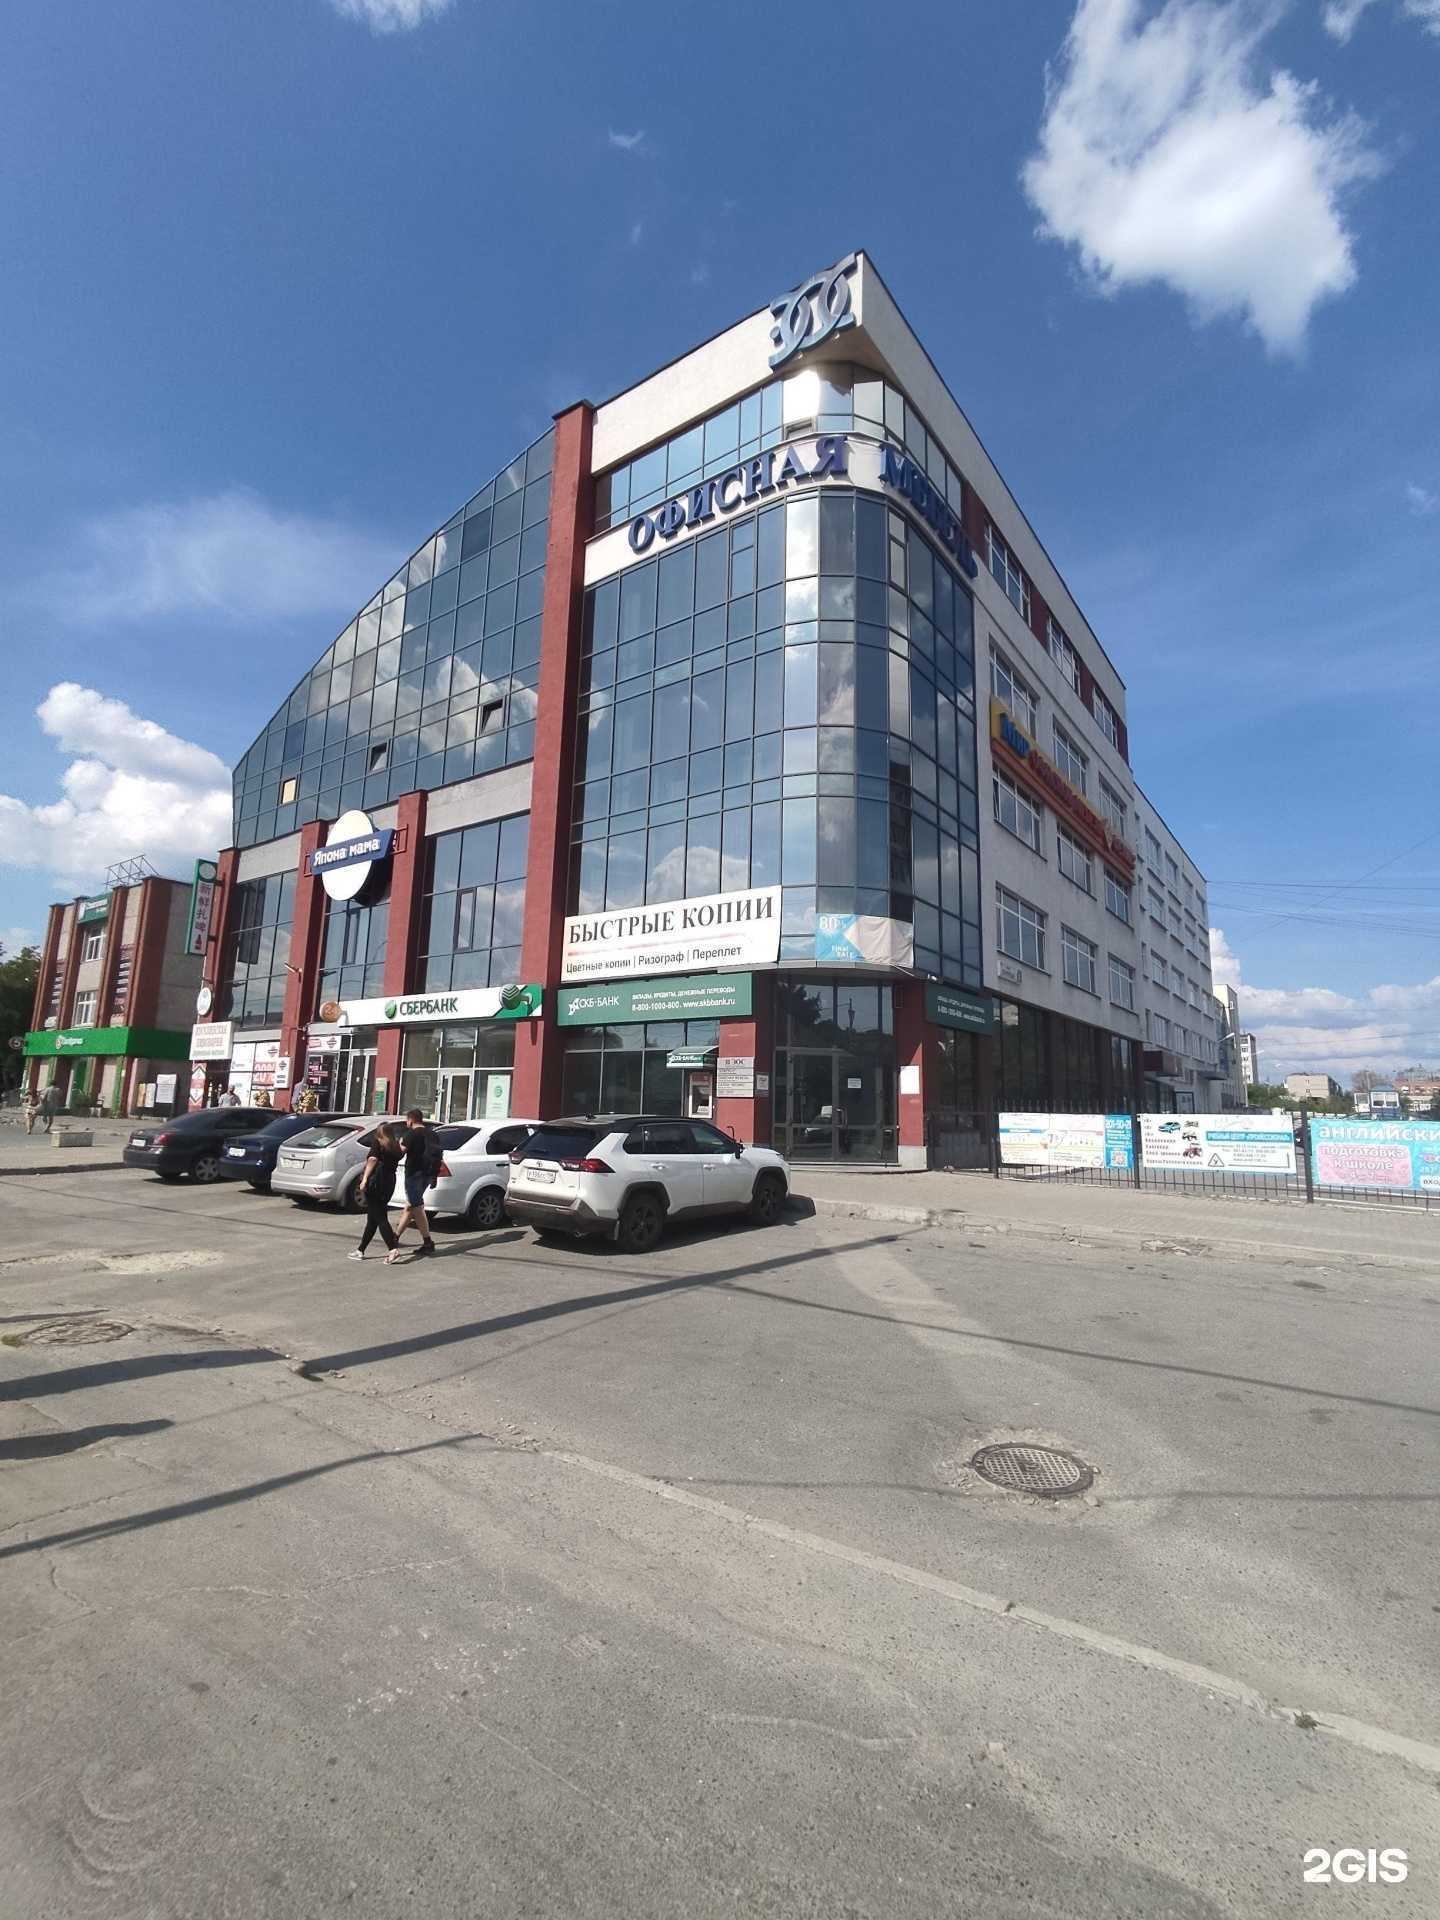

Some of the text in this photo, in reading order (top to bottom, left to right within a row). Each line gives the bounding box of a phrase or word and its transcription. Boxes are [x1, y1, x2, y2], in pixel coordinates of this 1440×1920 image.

[627, 435, 848, 555] ОФИСНАЯ
[349, 839, 381, 856] мама
[569, 896, 774, 944] БЫСТРЫЕ КОПИИ
[566, 946, 742, 974] Цветные копии Ризограф Переплет
[399, 997, 459, 1016] СБЕРБАНК
[1321, 1146, 1405, 1158] подготовка
[1345, 1160, 1393, 1170] школе
